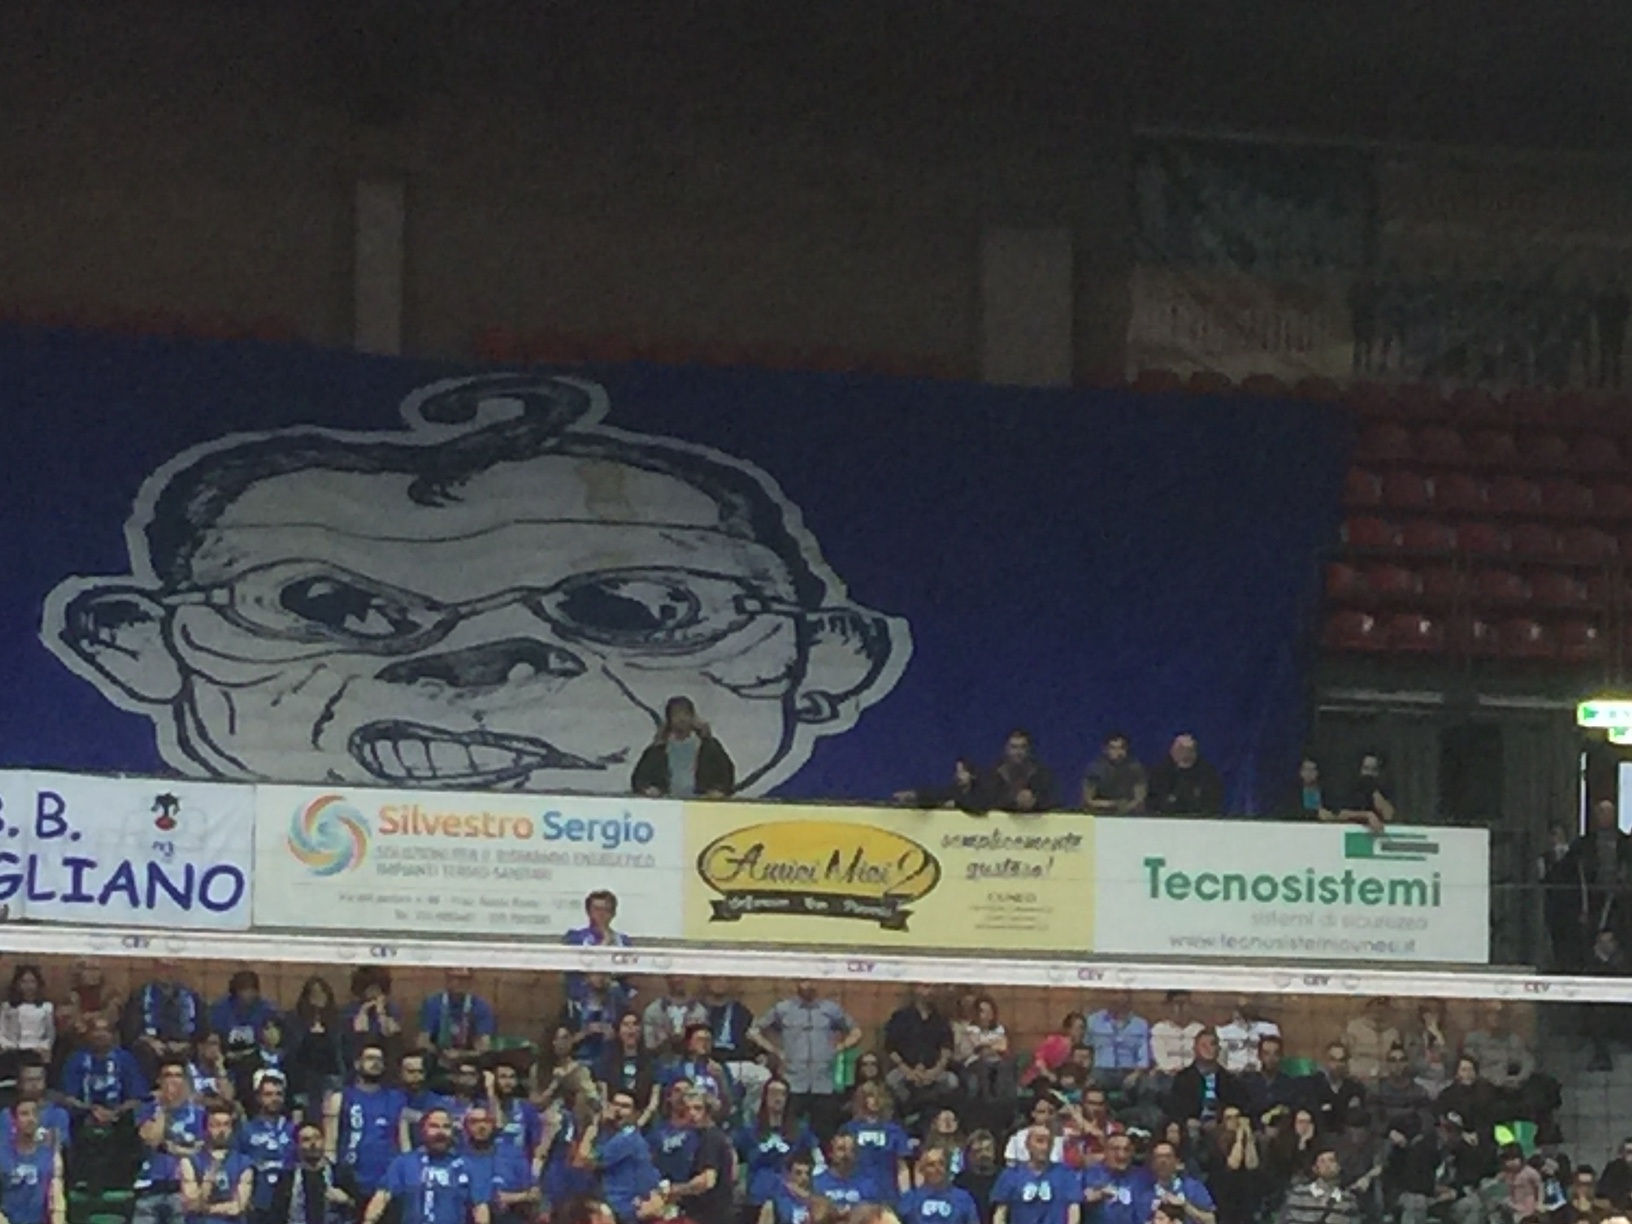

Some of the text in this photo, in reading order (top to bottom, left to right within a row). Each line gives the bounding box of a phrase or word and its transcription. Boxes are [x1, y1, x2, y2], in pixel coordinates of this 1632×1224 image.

[378, 804, 655, 849] Silvestro Sergio
[1143, 857, 1442, 908] Tecnosistemi
